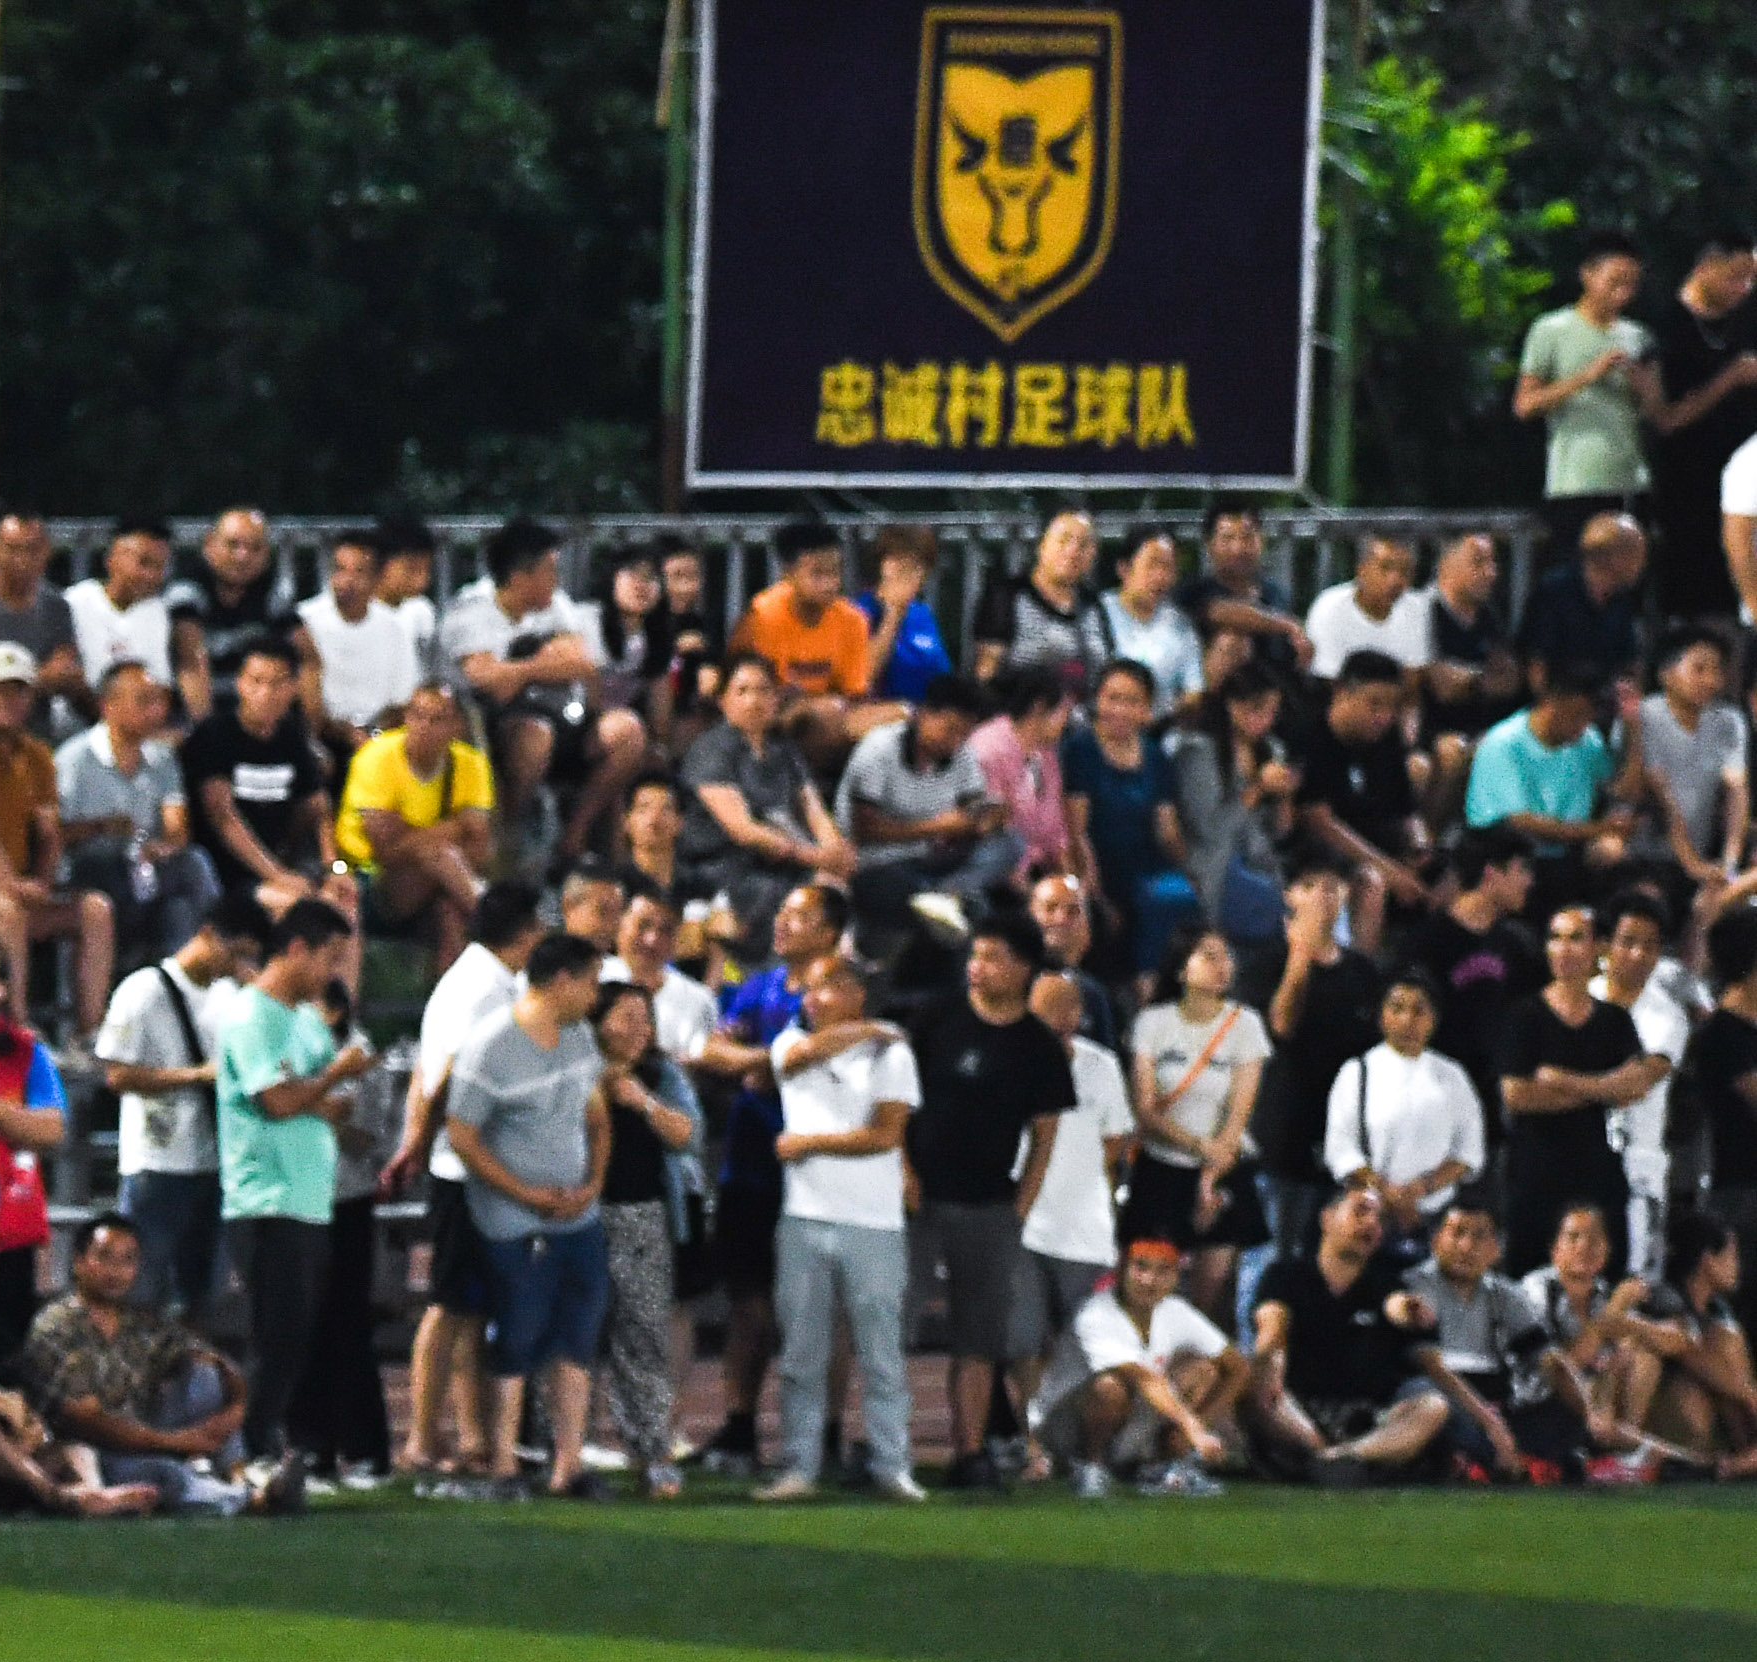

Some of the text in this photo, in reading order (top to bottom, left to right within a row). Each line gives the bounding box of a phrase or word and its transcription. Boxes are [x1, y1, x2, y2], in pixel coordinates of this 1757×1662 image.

[815, 357, 1196, 449] 忠诚村足球队
